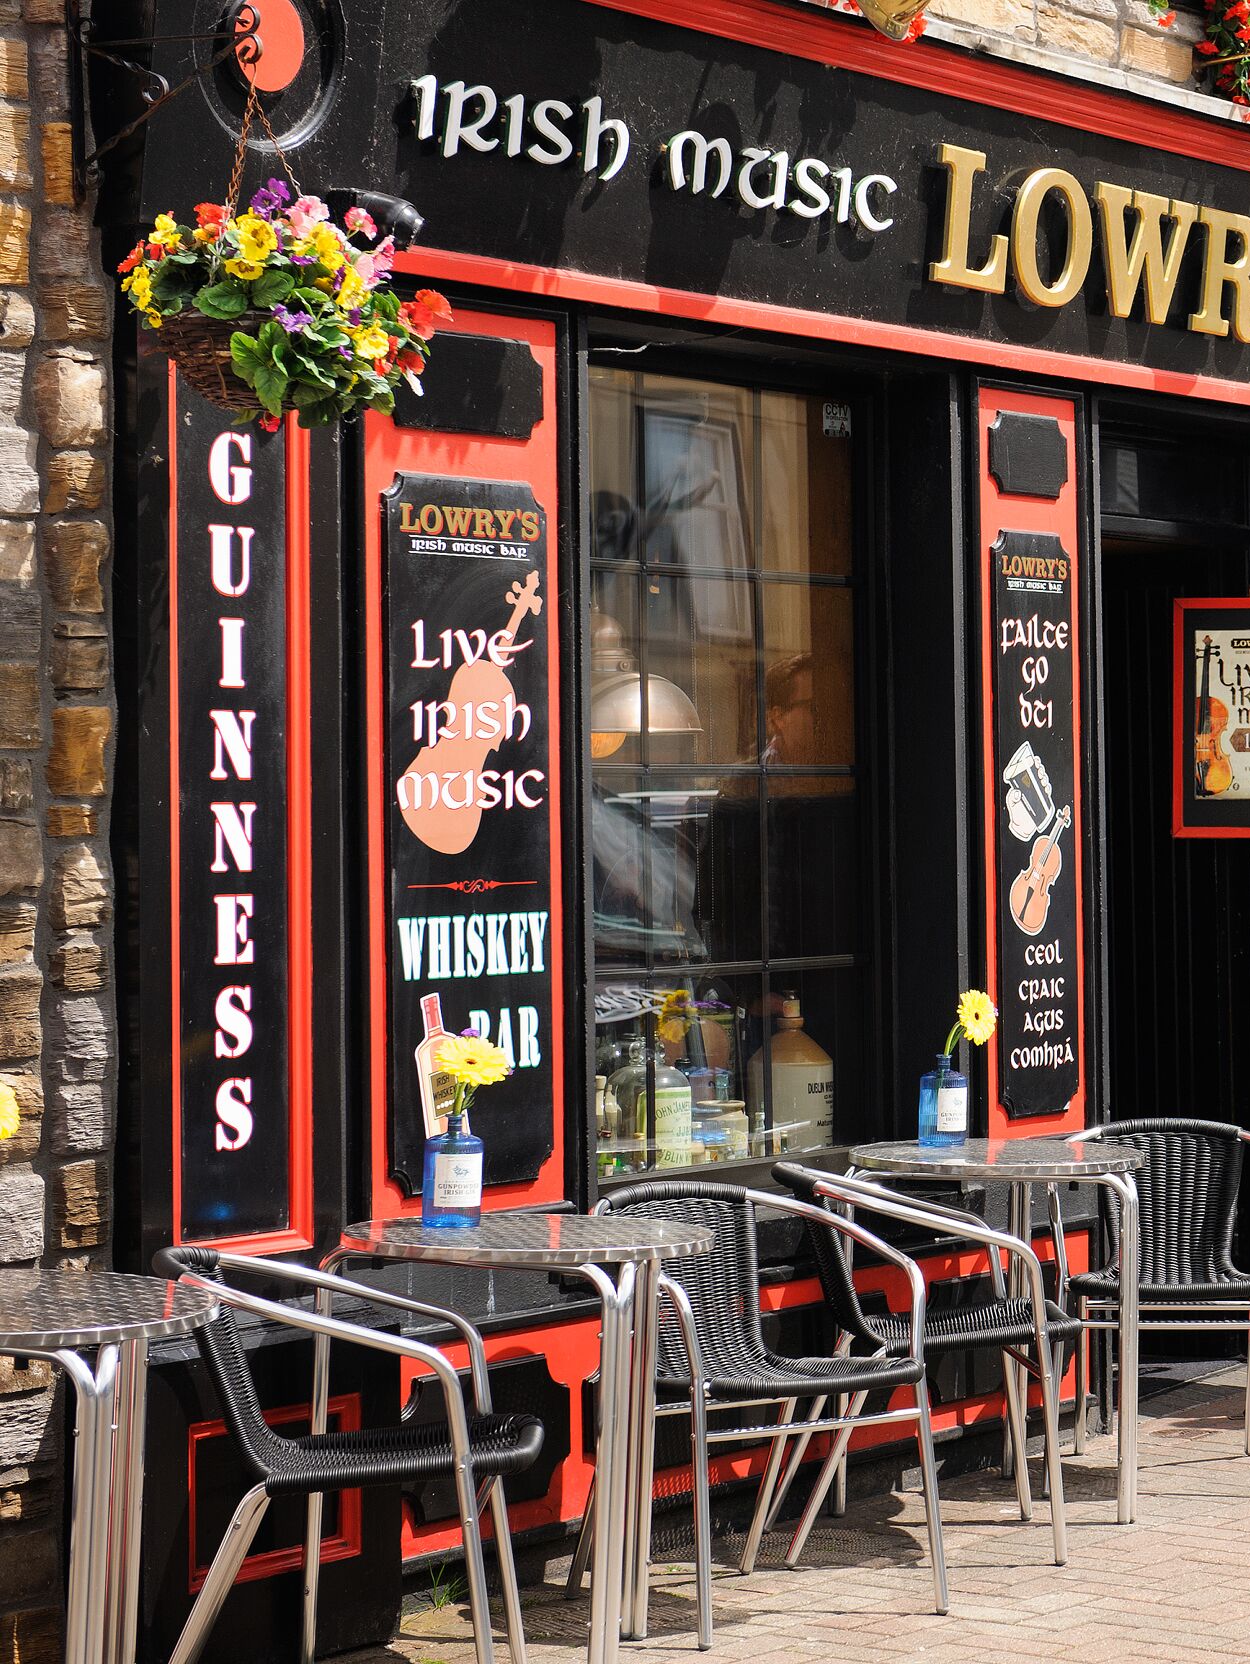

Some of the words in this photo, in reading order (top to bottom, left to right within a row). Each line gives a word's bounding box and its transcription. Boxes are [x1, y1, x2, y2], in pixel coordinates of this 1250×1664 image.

[825, 403, 849, 417] CCTV
[400, 502, 541, 541] LOWRY'S
[411, 539, 447, 551] IRISH
[452, 542, 496, 555] MUSIC
[1001, 555, 1068, 580] LOWRY'S
[410, 619, 533, 671] LIVE
[1021, 655, 1049, 695] GO
[209, 431, 256, 1151] GUINNESS
[397, 767, 544, 811] MUSIC
[398, 911, 548, 981] WHISKEY
[1025, 938, 1064, 966] CEOL
[1018, 976, 1065, 1005] CRAIC
[1023, 1008, 1064, 1037] AGUS
[436, 1075, 450, 1087] IRISH
